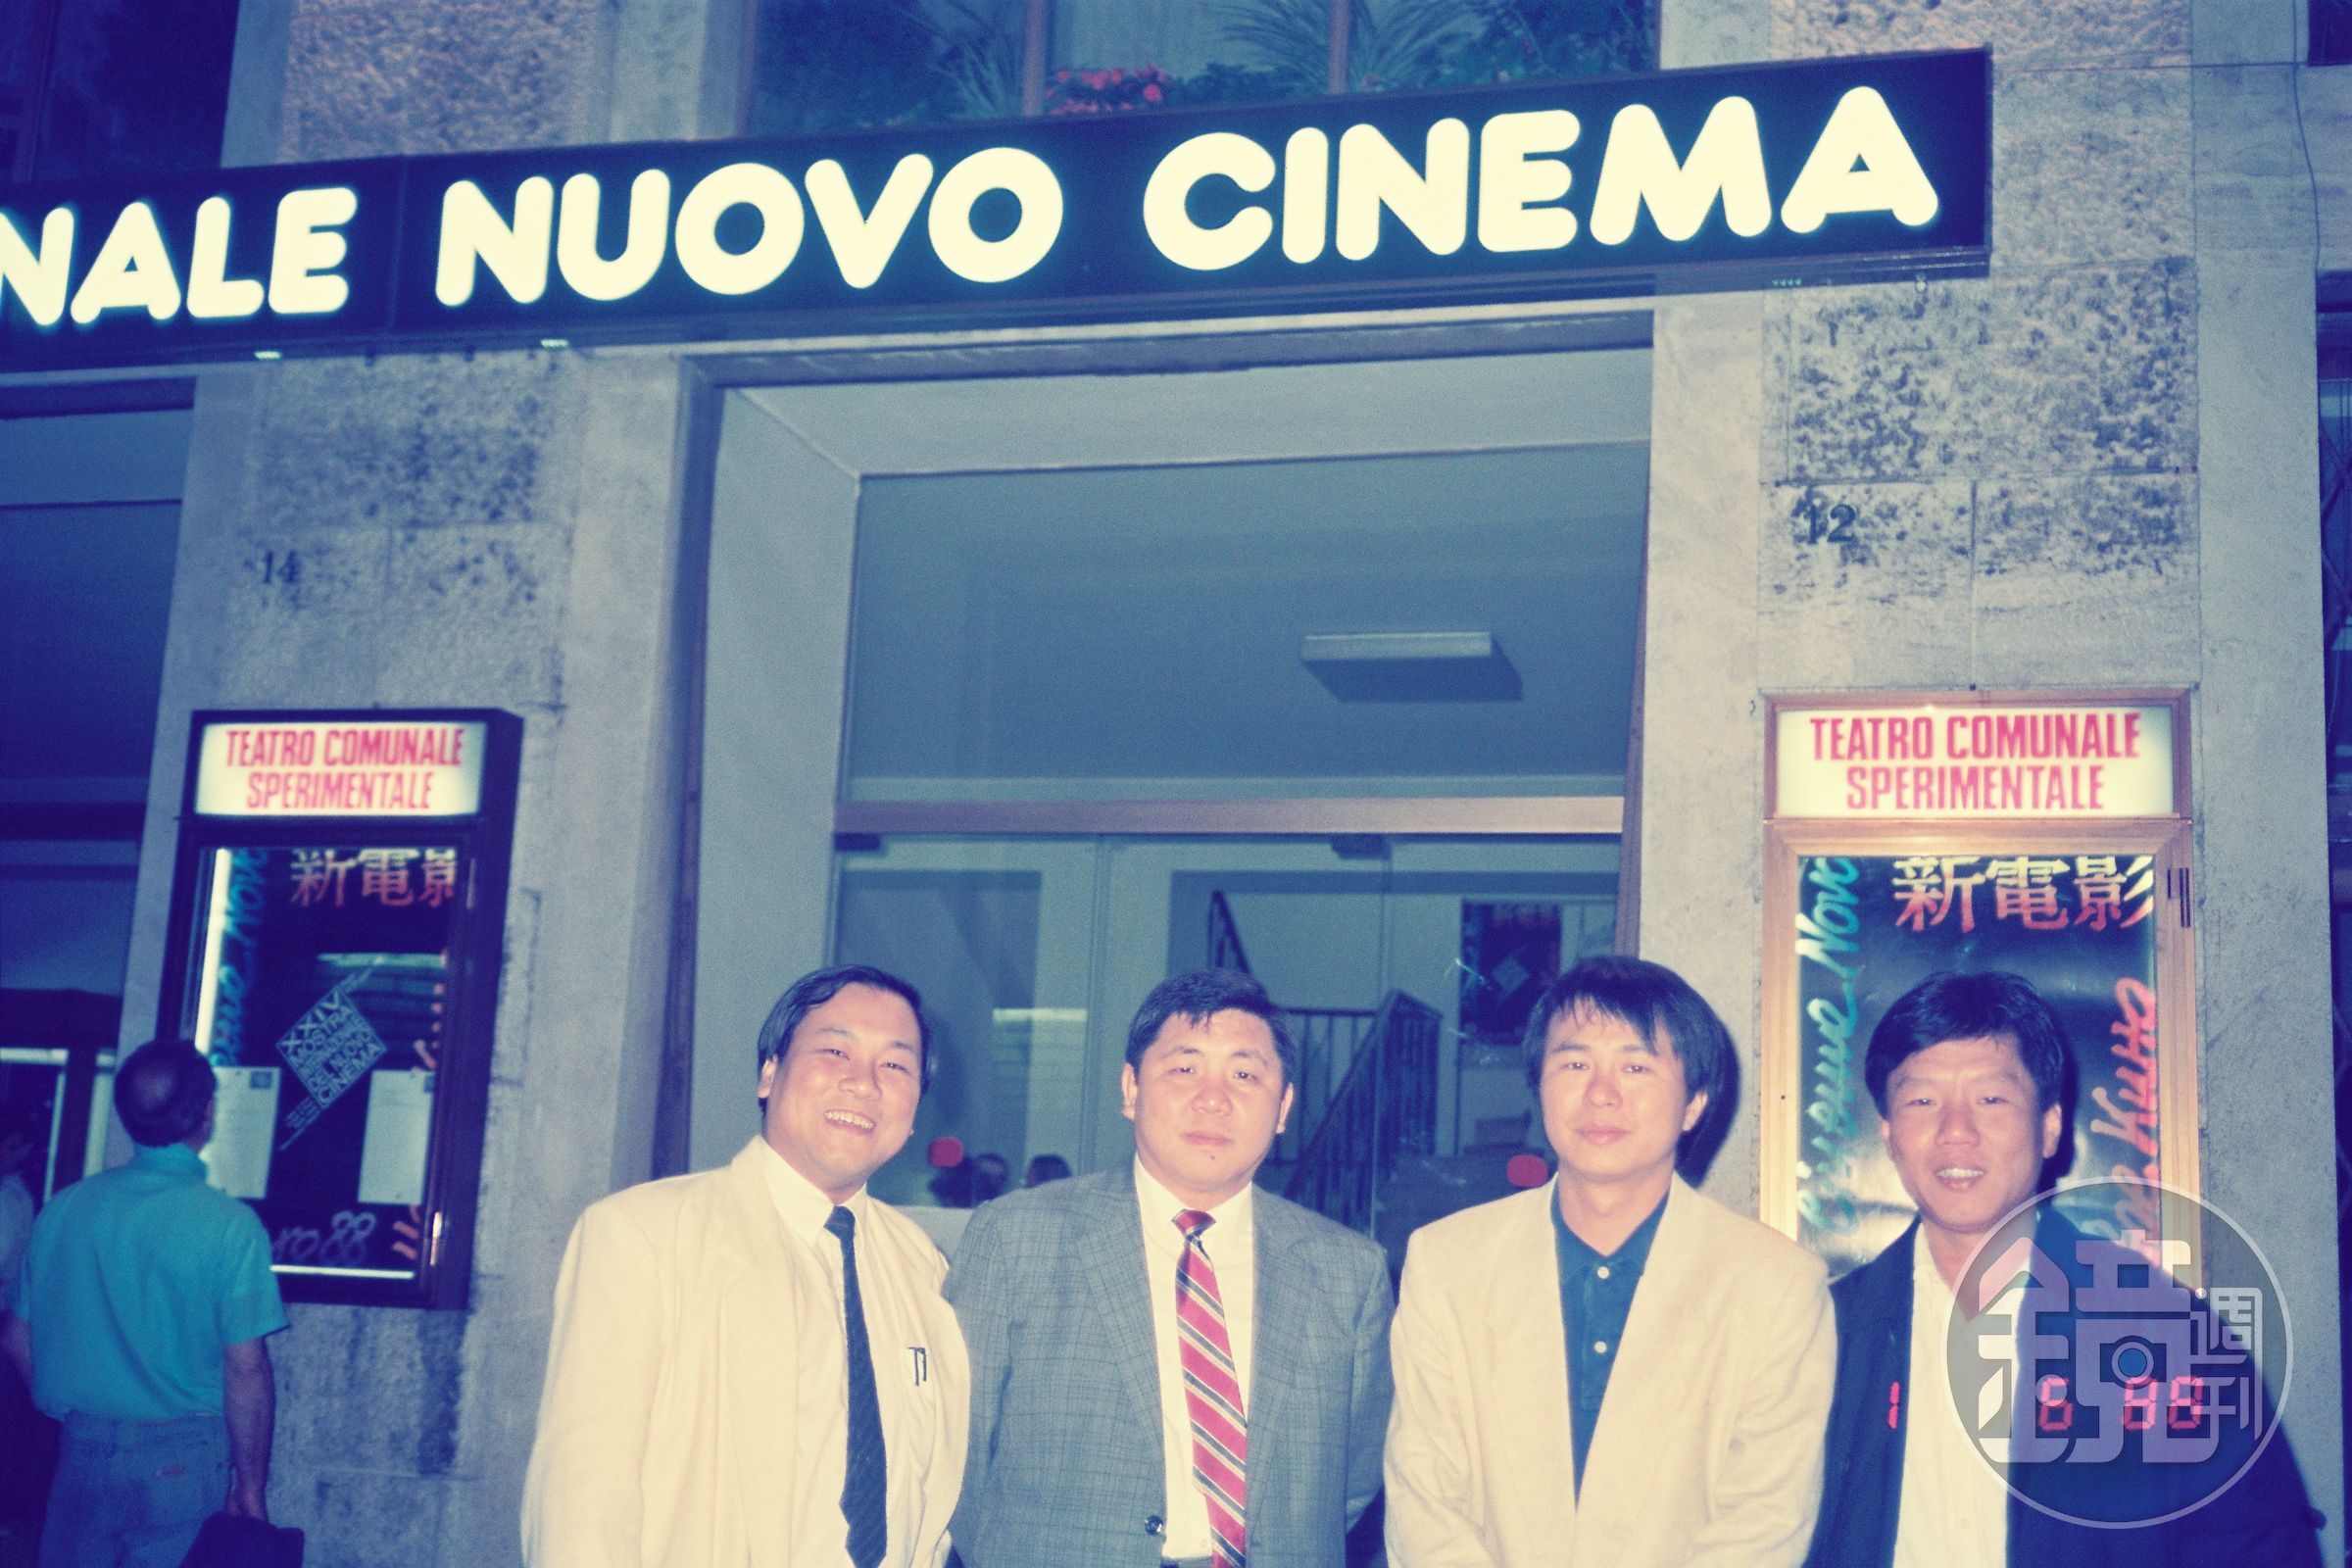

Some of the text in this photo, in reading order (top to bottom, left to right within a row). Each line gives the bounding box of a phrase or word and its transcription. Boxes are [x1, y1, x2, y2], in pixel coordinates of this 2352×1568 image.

[0, 86, 1938, 325] NALE NUOVO CINEMA
[1807, 503, 1857, 545] 12
[263, 550, 300, 584] 14
[225, 728, 466, 767] TEATRO COMUNALE
[1809, 712, 2142, 761] TEATRO COMUNALE
[246, 771, 435, 810] SPERIMENTALE
[1846, 765, 2105, 810] SPERIMENTALE
[1890, 855, 2154, 934] 新電影
[281, 990, 340, 1054] XXIV
[289, 1004, 354, 1068] MOSTRA
[318, 1041, 381, 1102] CINEMA
